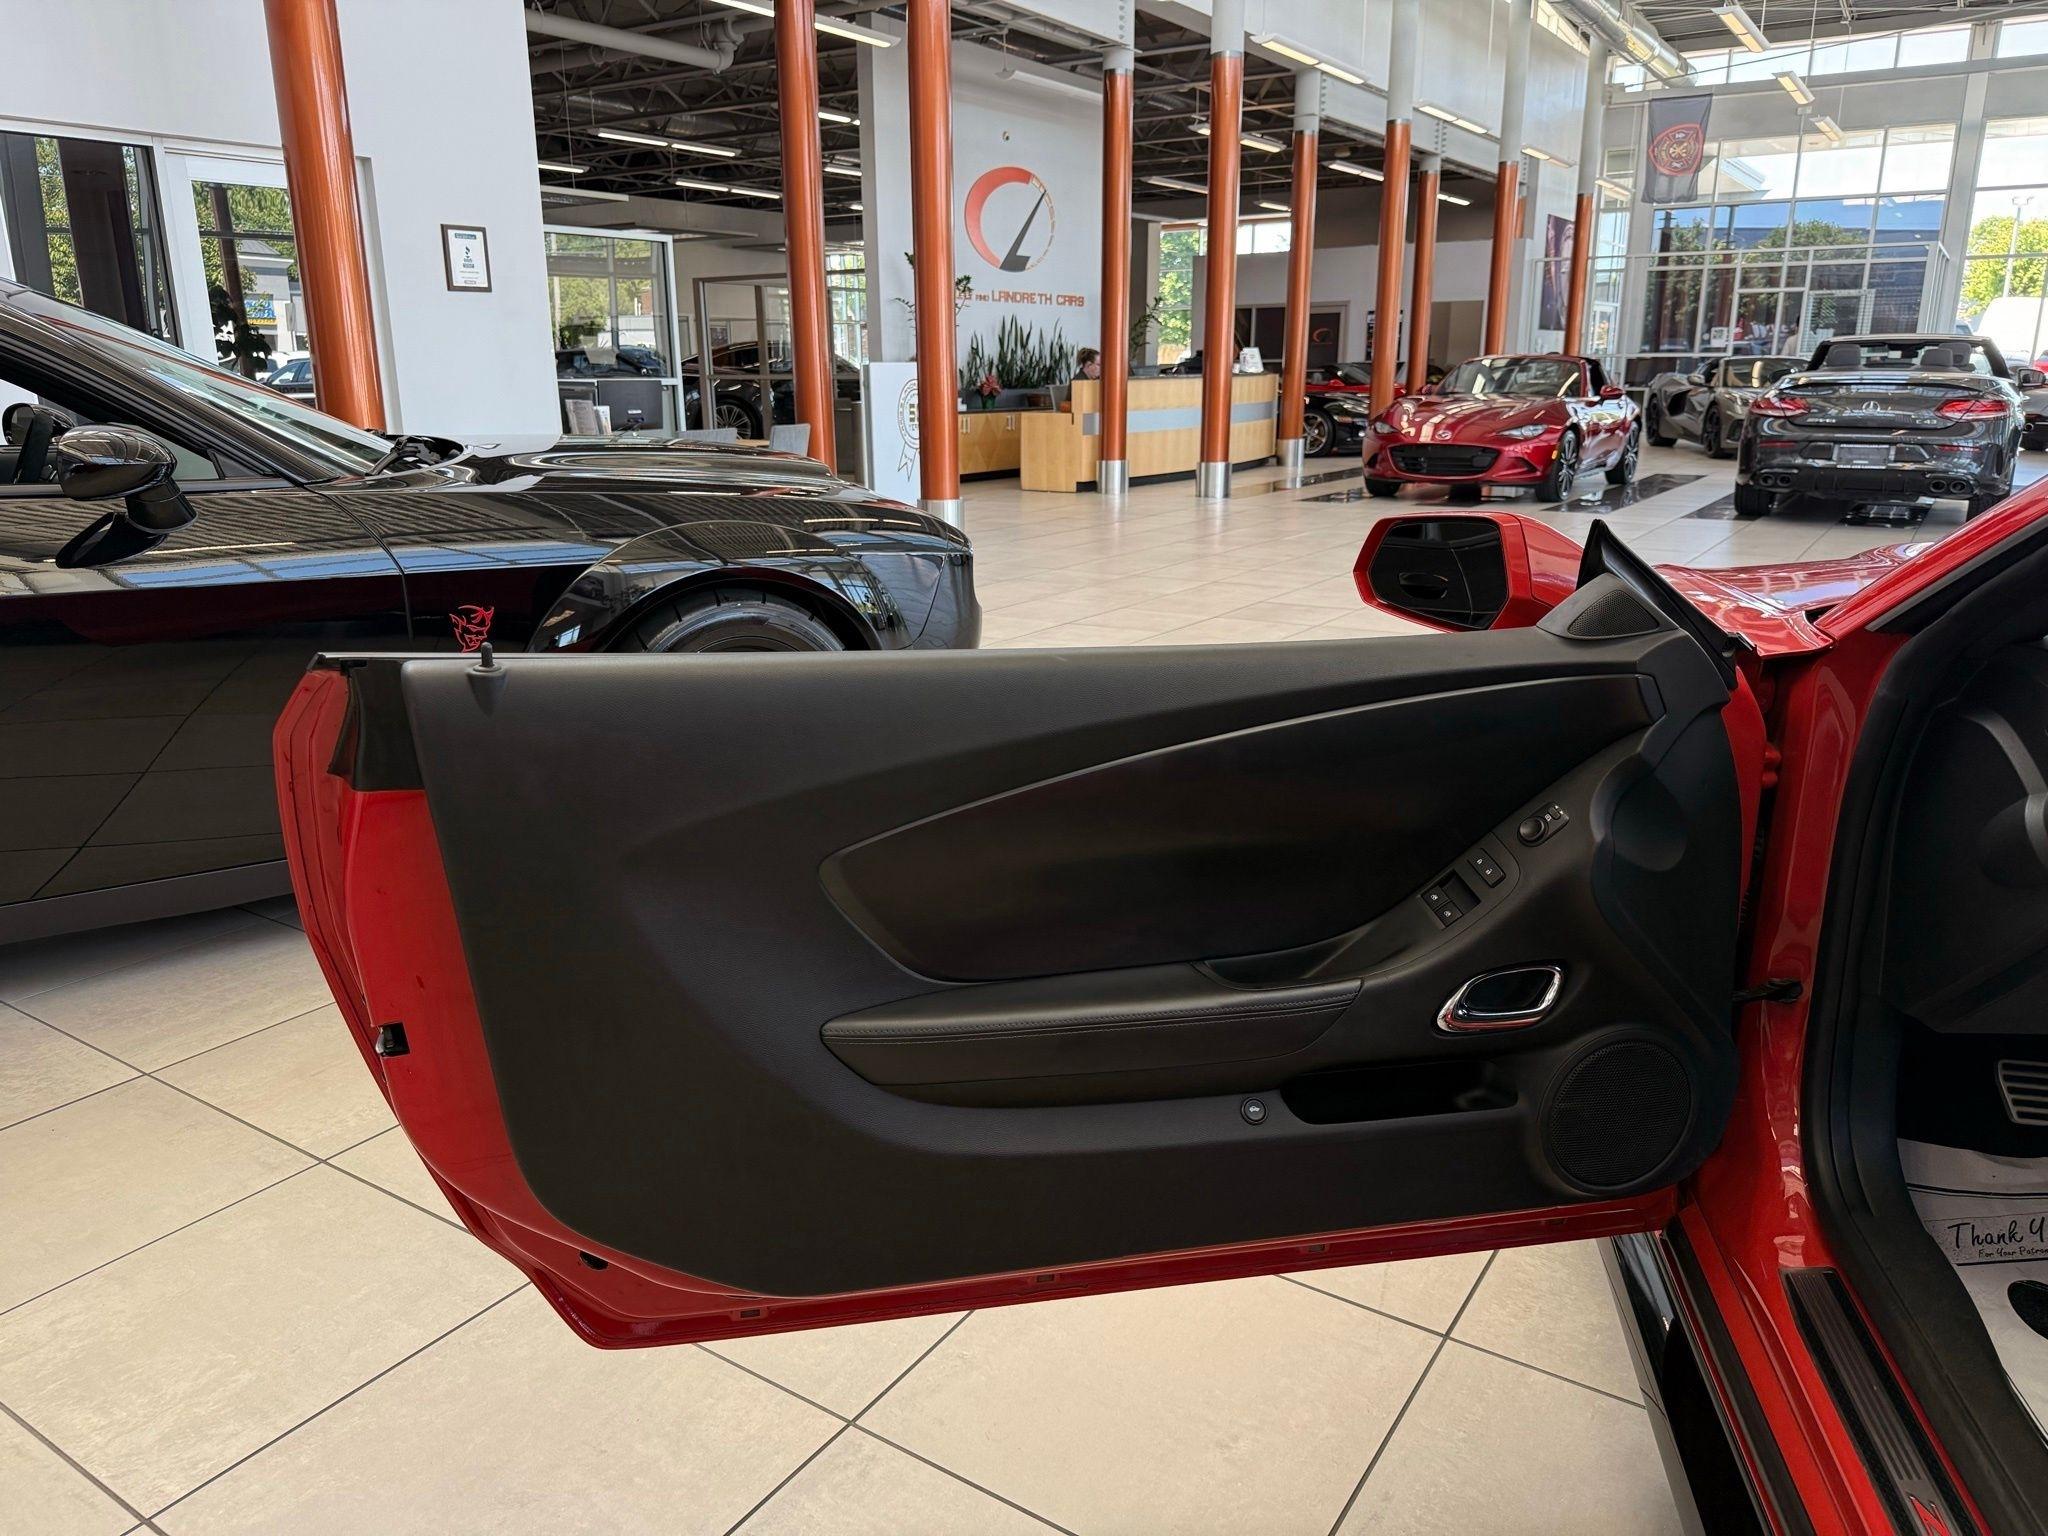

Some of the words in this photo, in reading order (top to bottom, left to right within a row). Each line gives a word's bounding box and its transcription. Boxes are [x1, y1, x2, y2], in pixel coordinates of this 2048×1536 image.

[991, 290, 1053, 306] LANDRETH
[1056, 294, 1085, 308] CARS
[1947, 1219, 2024, 1250] Thank
[1978, 1248, 1994, 1258] For
[1996, 1247, 2017, 1257] Your
